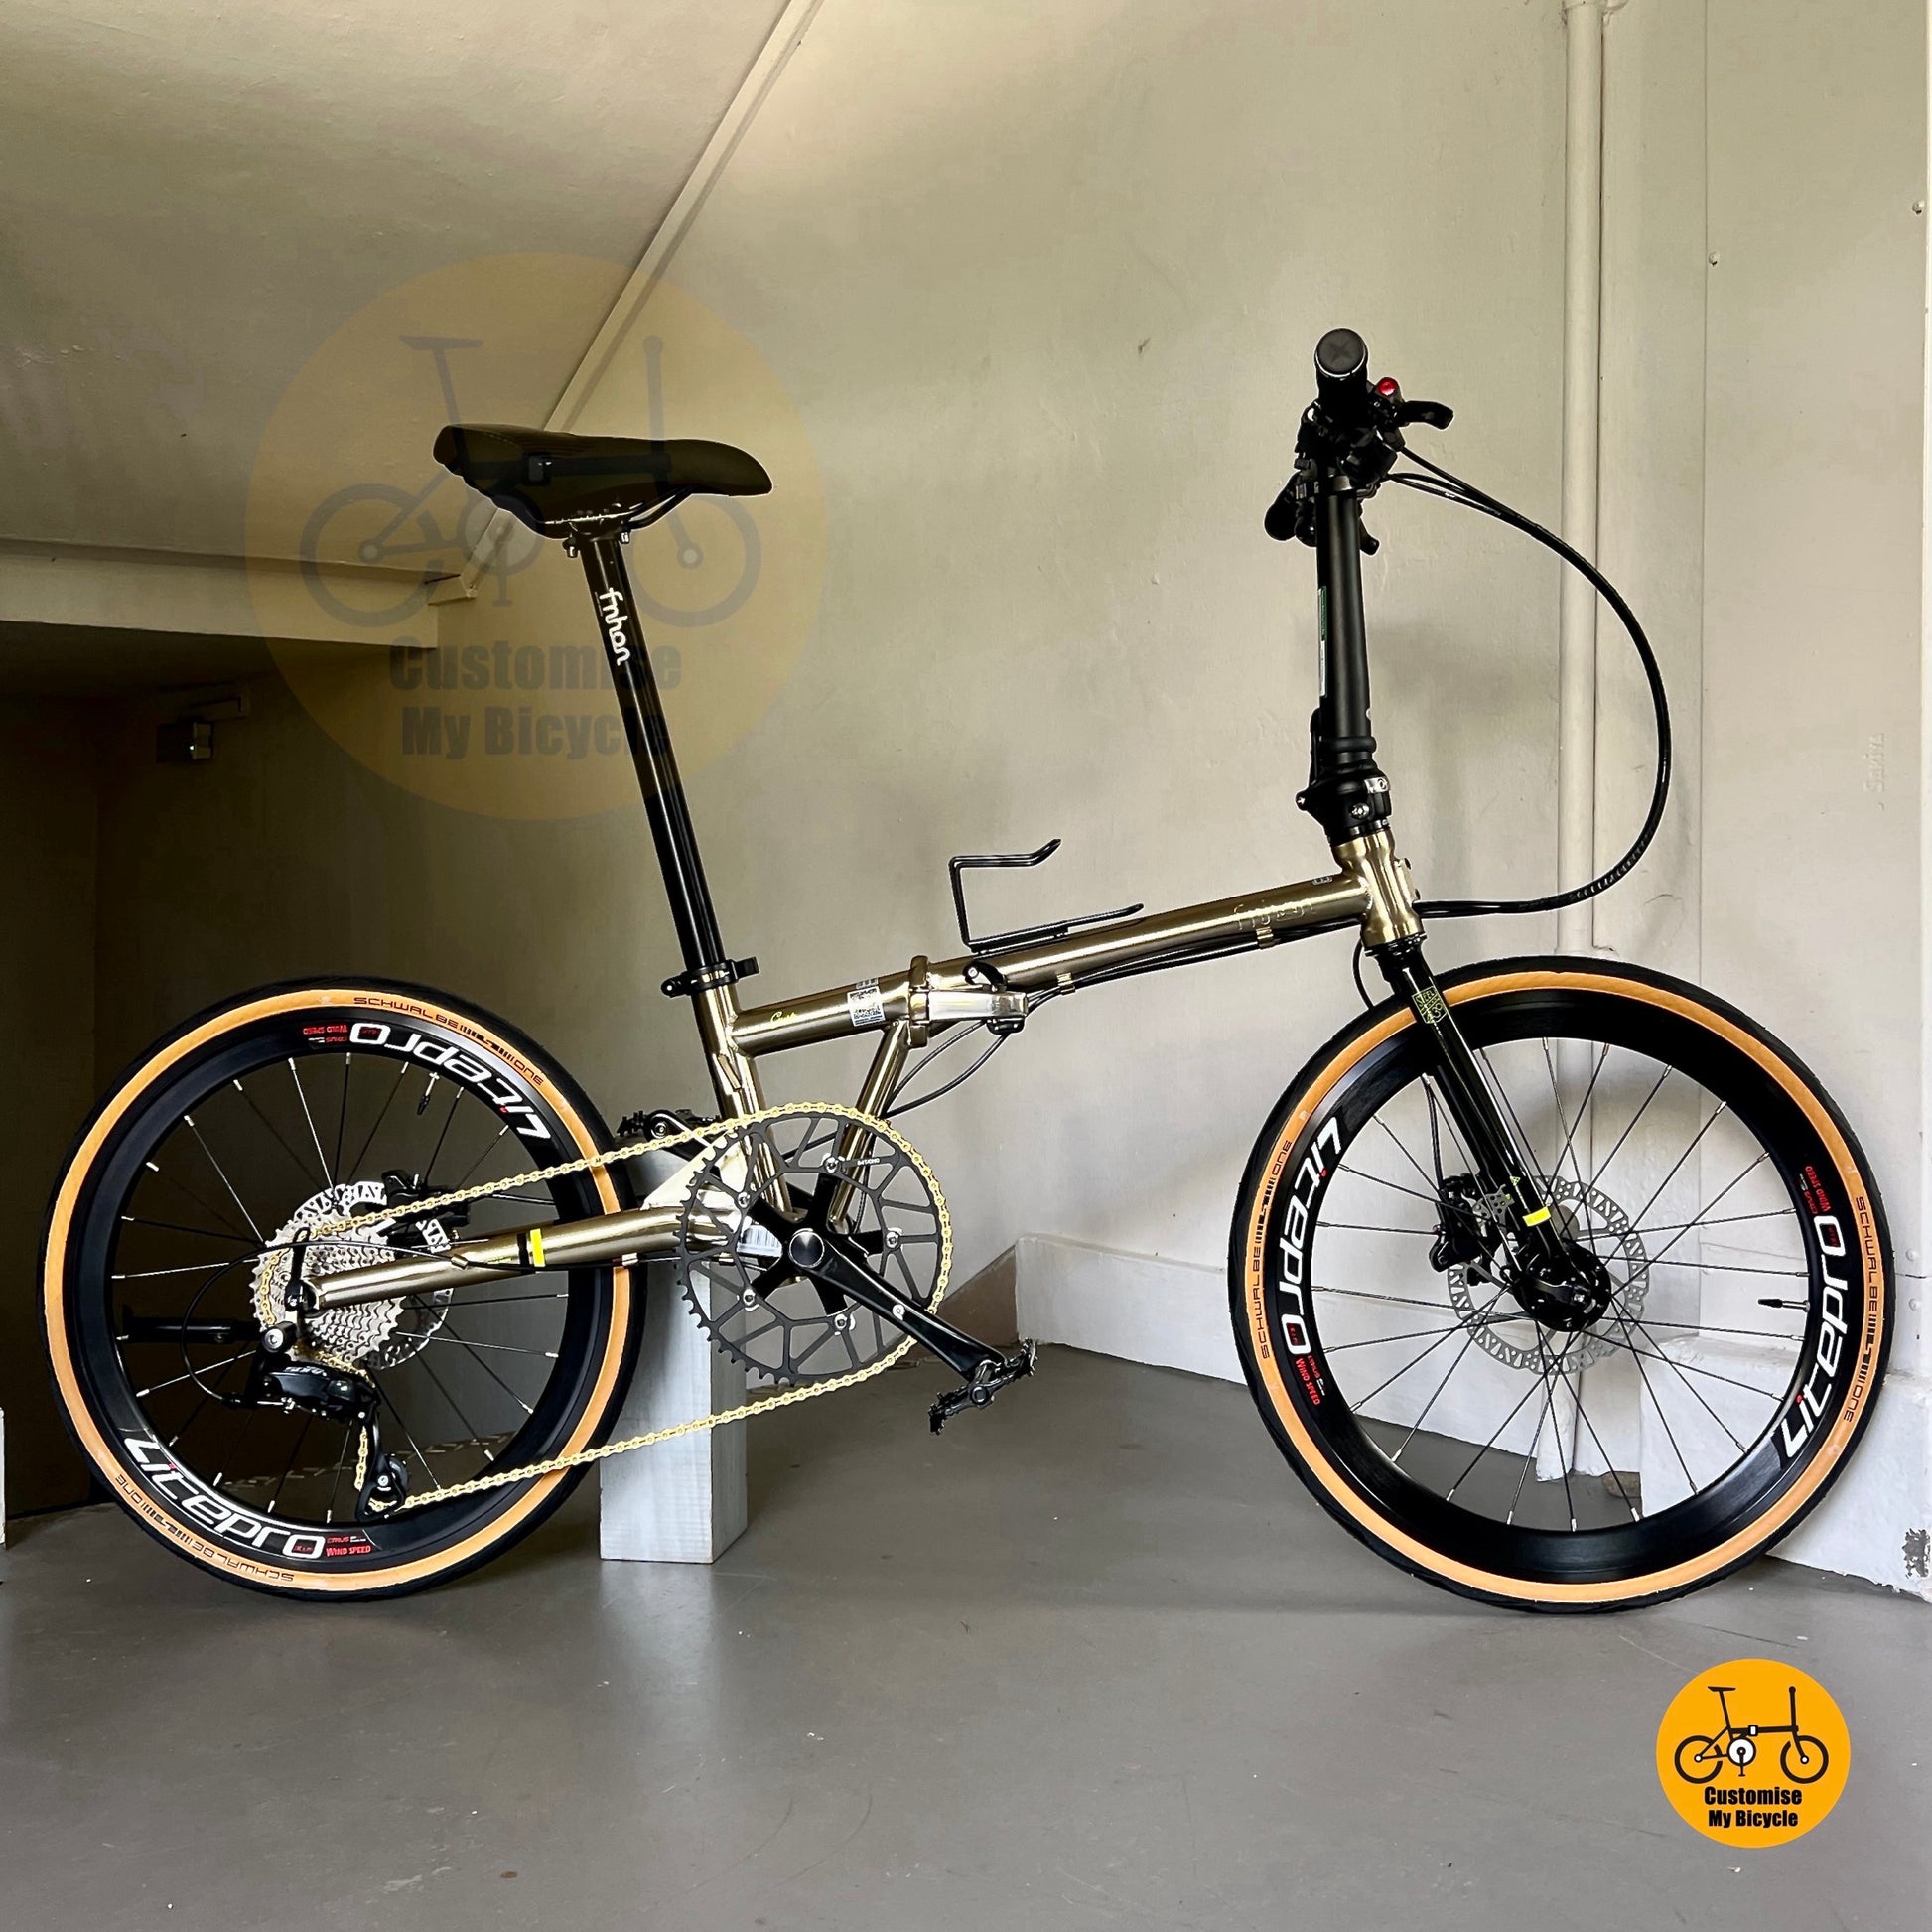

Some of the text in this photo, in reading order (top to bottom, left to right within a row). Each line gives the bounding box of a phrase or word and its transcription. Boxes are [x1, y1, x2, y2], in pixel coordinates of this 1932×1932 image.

[599, 587, 631, 666] fnhon
[353, 996, 544, 1086] SCHWALBE ONE
[1252, 1139, 1292, 1359] SCHWALBE ONE
[1843, 1196, 1878, 1423] SCHWALBE ONE
[114, 1473, 295, 1583] SCHWALBE ONE
[348, 1545, 371, 1555] SPEED
